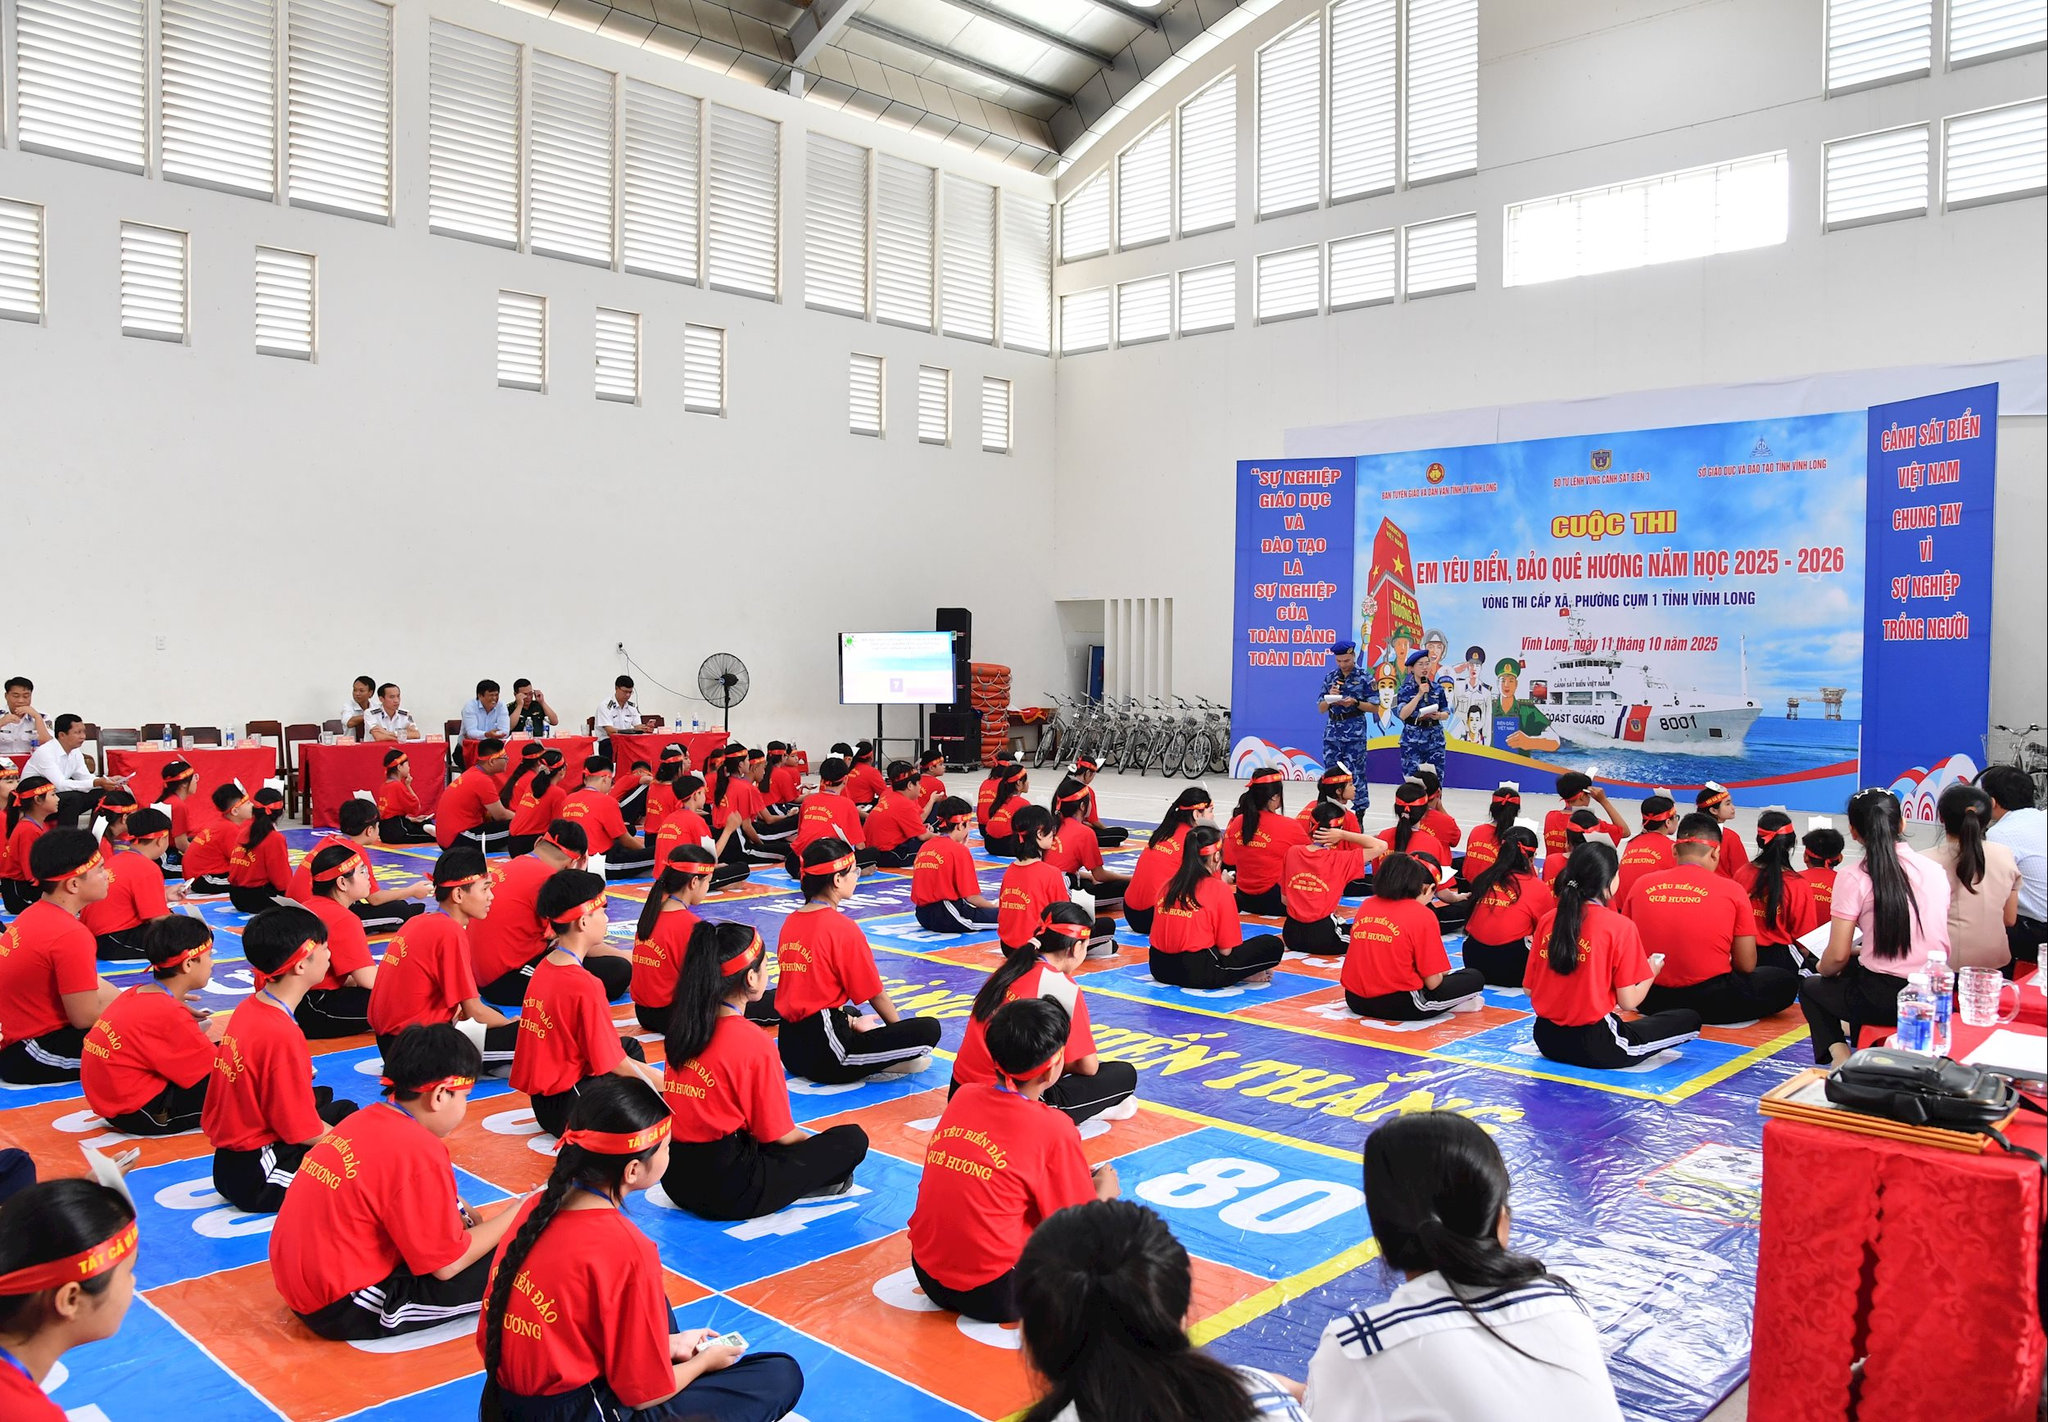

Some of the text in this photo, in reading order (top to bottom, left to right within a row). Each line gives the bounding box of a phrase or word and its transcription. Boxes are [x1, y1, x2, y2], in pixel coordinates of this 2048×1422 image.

[1881, 407, 1981, 452] CẢNH SÁT BIỂN
[1809, 459, 1827, 470] LONG
[1251, 467, 1341, 488] “SỰ NGHIỆP
[1645, 472, 1650, 481] 3
[1897, 459, 1960, 492] VIỆT NAM
[1483, 482, 1498, 493] LONG
[1259, 491, 1331, 510] GIÁO DỤC
[1284, 513, 1305, 530] VÀ
[1551, 510, 1677, 541] CUỘC THI
[1892, 502, 1963, 531] CHUNG TAY
[1261, 536, 1326, 555] ĐÀO TẠO
[1919, 535, 1933, 562] VÌ
[1284, 558, 1303, 575] LÀ
[1416, 546, 1845, 584] EM YÊU BIỂN, ĐẢO QUÊ HƯƠNG NĂM HỌC 2025 - 2026
[1254, 581, 1336, 601] SỰ NGHIỆP
[1891, 569, 1960, 603] SỰ NGHIỆP
[1393, 589, 1415, 609] ĐẢO
[1482, 589, 1756, 610] VÒNG THI CẤP XÃ, PHƯỜNG CỤM 1 TỈNH VĨNH LONG
[1277, 602, 1308, 621] CỦA
[1248, 624, 1336, 644] TOÀN ĐẢNG
[1883, 611, 1969, 640] TRỒNG NGƯỜI
[1521, 636, 1718, 653] Vĩnh Long, ngày 11 tháng 10 năm 2025
[1248, 649, 1289, 666] TOÀN
[1572, 713, 1605, 725] GUARD
[1660, 715, 1698, 731] 8001
[1648, 894, 1701, 904] QUÊ HƯƠNG
[1367, 932, 1393, 944] HƯƠNG
[1578, 938, 1592, 953] ĐẢO
[698, 1062, 716, 1088] ĐẢO
[943, 1125, 964, 1138] YÊU
[986, 1143, 1008, 1169] ĐẢO
[306, 1159, 342, 1191] HƯƠNG
[342, 1151, 361, 1180] ĐẢO
[927, 1149, 993, 1181] QUÊ HƯƠNG
[1135, 1157, 1365, 1234] 80
[78, 1238, 125, 1275] TẤT CẢ
[513, 1270, 558, 1324] IỂN ĐẢO
[503, 1312, 543, 1341] ƯƠNG
